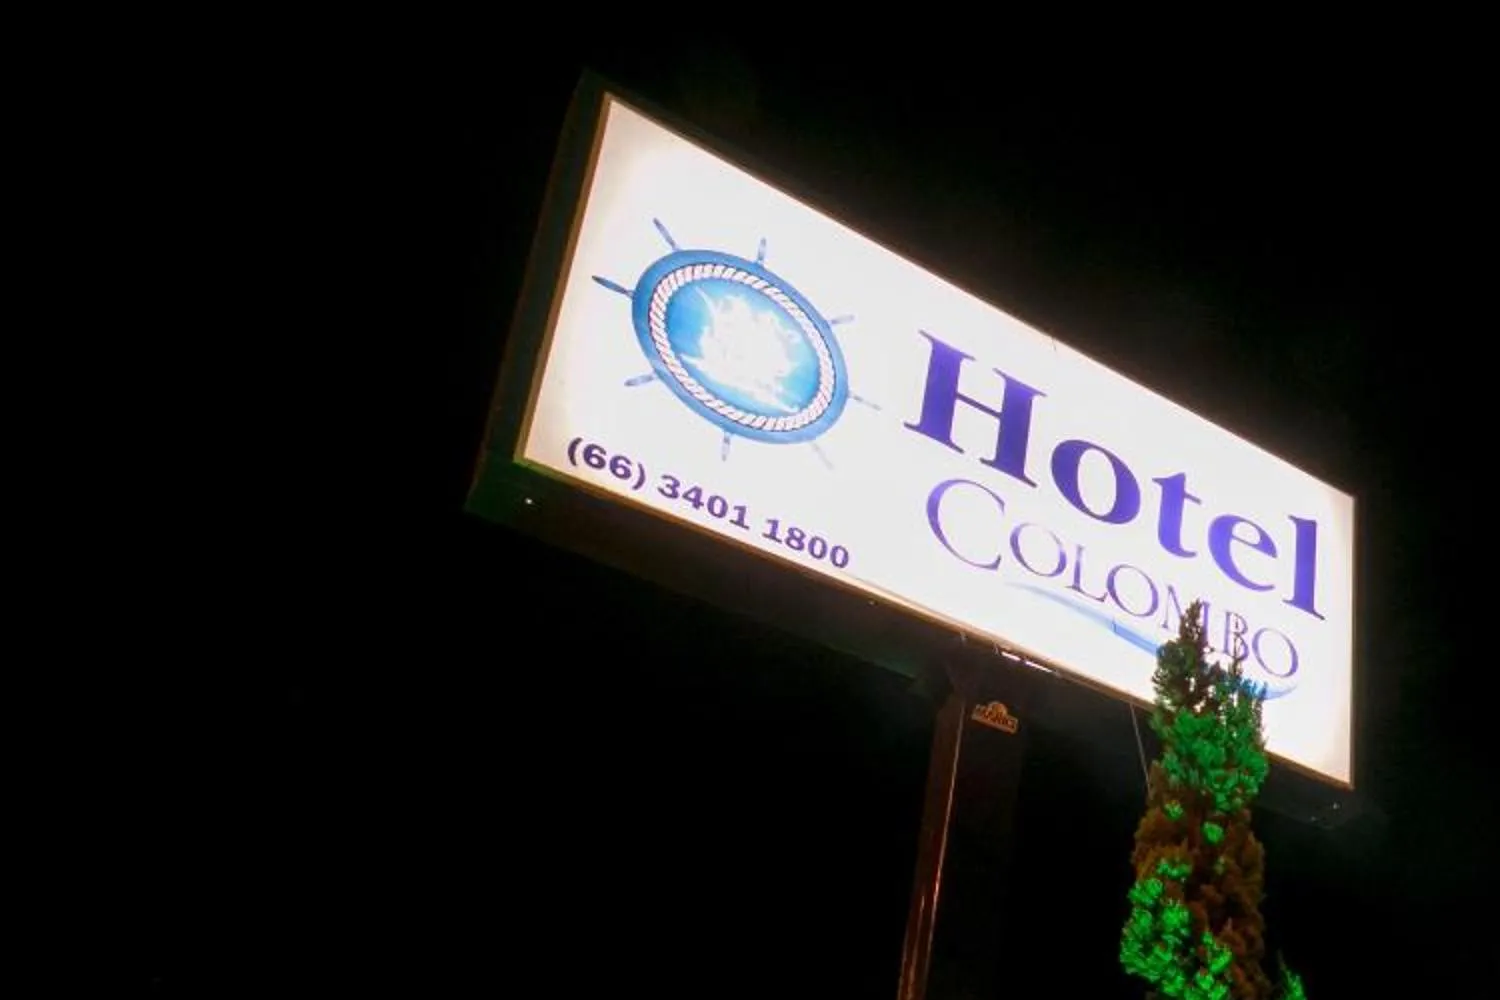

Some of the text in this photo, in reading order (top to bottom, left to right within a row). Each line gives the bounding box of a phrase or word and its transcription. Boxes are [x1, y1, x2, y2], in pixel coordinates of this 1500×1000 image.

[567, 437, 849, 568] (66) 3401 1800
[904, 330, 1325, 620] Hotel
